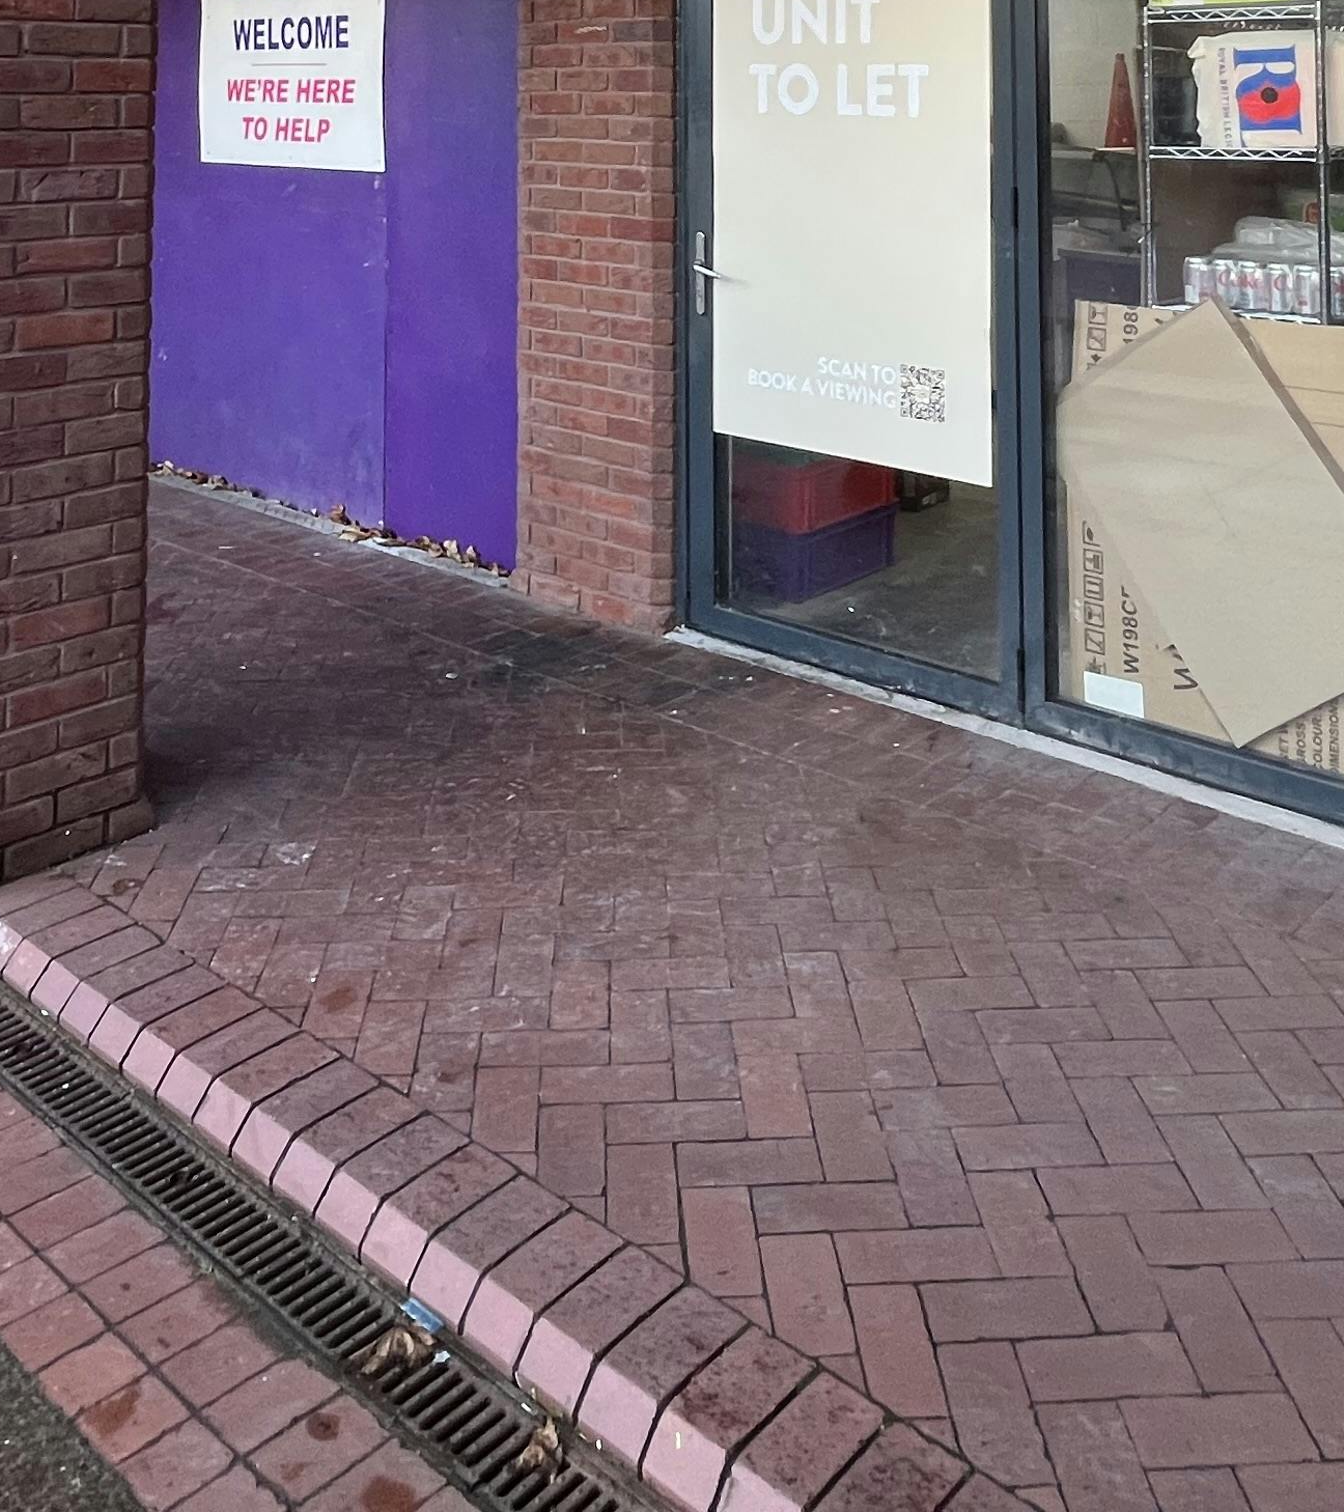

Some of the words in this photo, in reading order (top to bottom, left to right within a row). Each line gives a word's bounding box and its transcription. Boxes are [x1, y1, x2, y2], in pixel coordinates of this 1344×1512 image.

[233, 15, 349, 50] WELCOME
[227, 79, 289, 103] WE'RE
[296, 79, 356, 103] HERE
[748, 63, 819, 115] TO
[836, 63, 929, 118] LET
[242, 117, 268, 140] TO
[275, 117, 330, 143] HELP
[816, 356, 866, 381] SCAN
[871, 364, 897, 385] TO
[748, 368, 797, 392] BOOK
[801, 379, 814, 396] A
[816, 379, 897, 409] VIEWING
